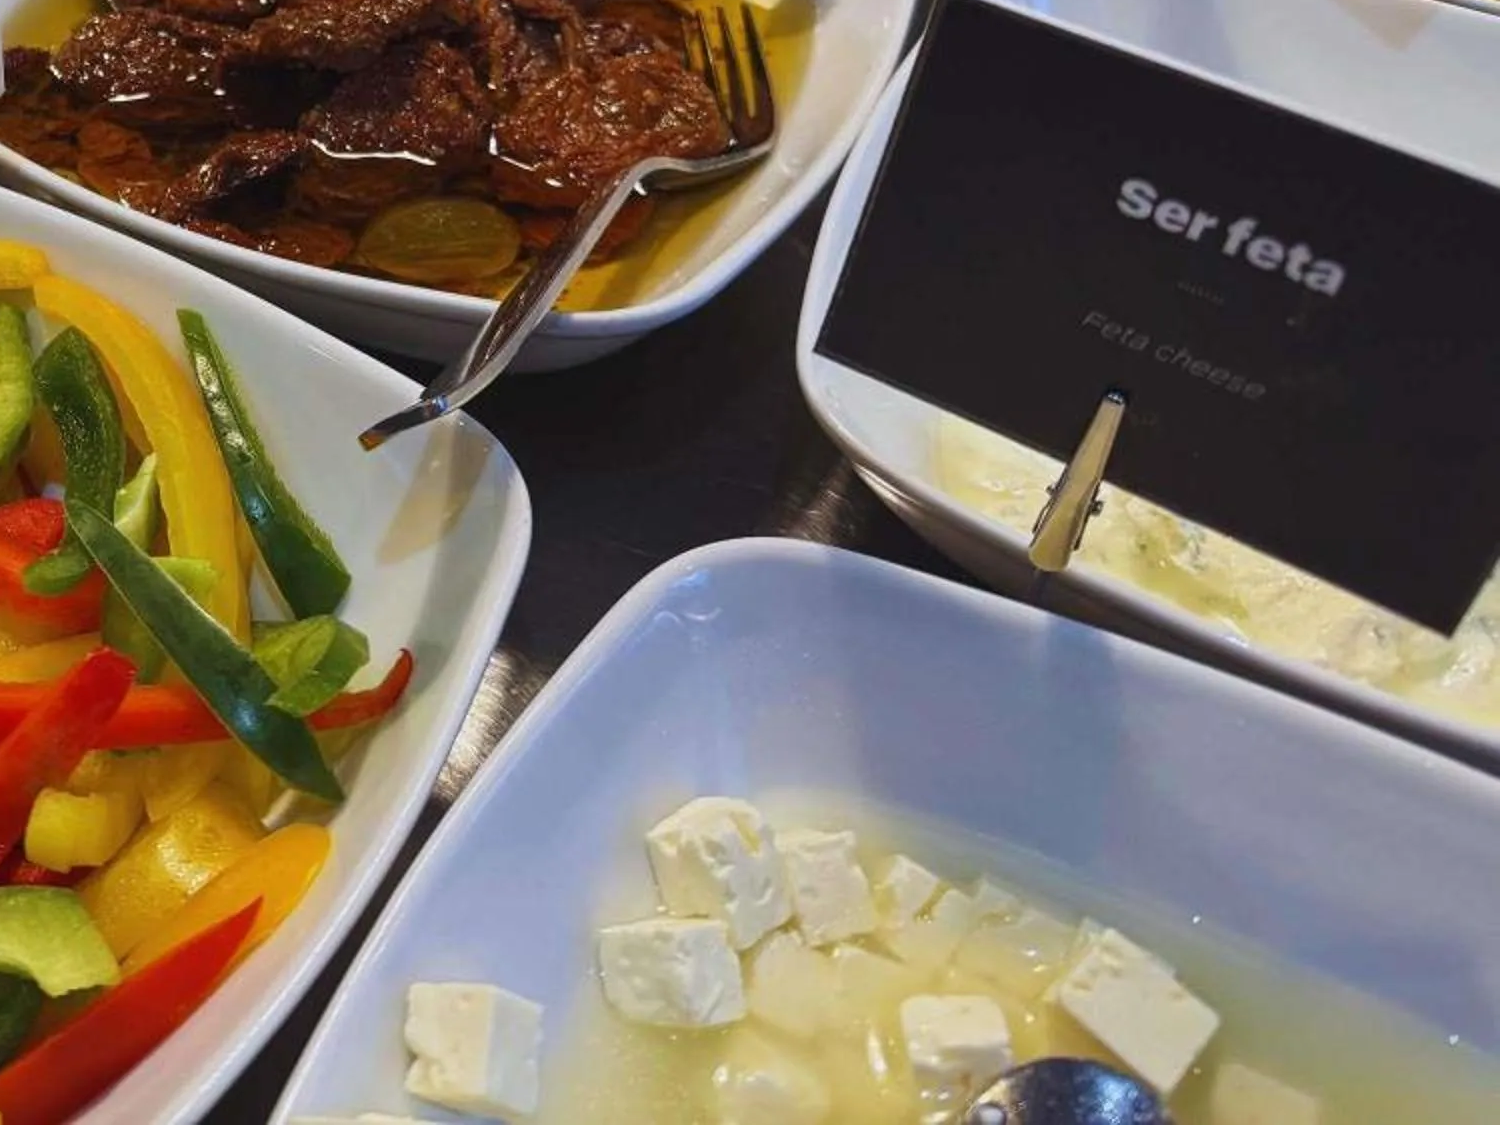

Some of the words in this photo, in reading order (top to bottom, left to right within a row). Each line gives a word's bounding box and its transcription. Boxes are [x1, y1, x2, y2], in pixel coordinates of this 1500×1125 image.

[1115, 177, 1218, 242] Ser
[1221, 216, 1347, 297] feta
[1081, 309, 1150, 352] Feta
[1154, 340, 1267, 402] cheese
